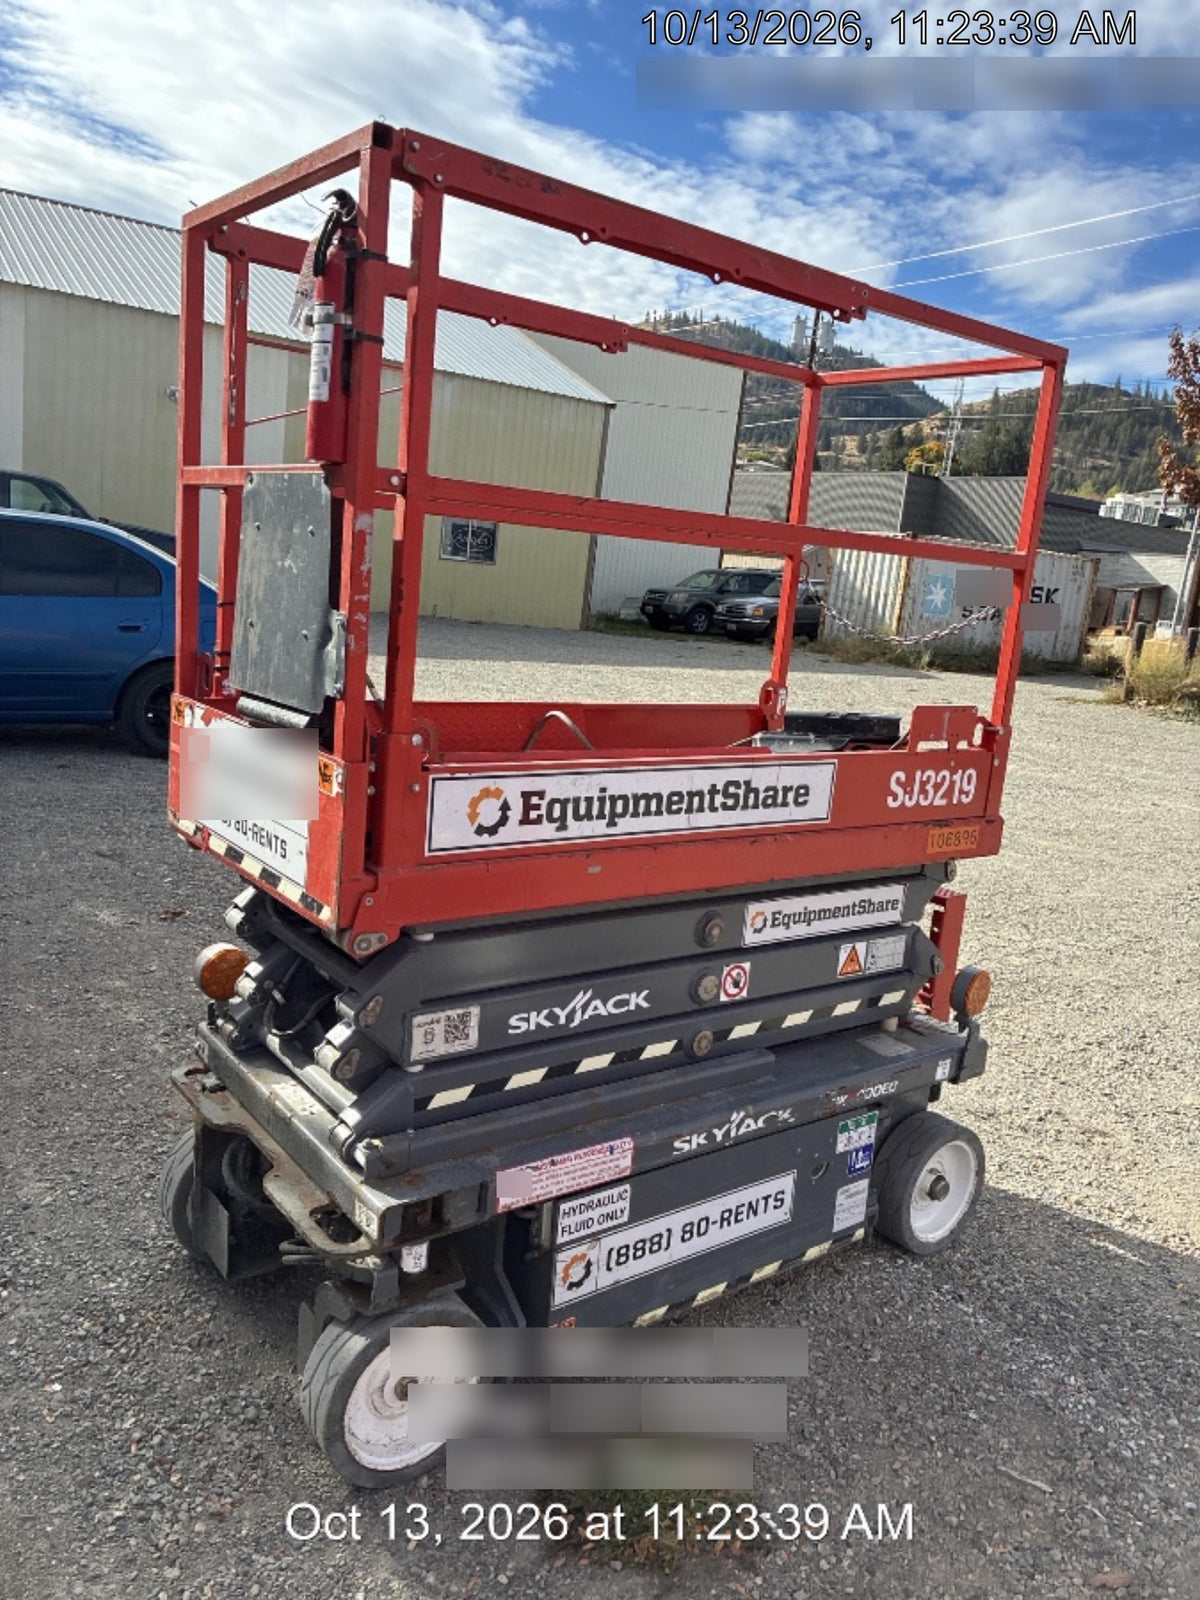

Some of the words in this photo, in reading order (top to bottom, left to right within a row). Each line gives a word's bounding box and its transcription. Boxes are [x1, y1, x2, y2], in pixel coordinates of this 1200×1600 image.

[519, 780, 810, 832] EquipmentShare
[886, 768, 977, 808] SJ3219
[770, 897, 900, 930] EquipmentShare
[508, 988, 651, 1034] SKYJACK
[561, 1189, 628, 1219] HYDRAULIC
[561, 1218, 594, 1239] FLUID
[596, 1207, 627, 1226] ONLY
[605, 1228, 673, 1272] (888)
[680, 1190, 785, 1244] 80-RENTS
